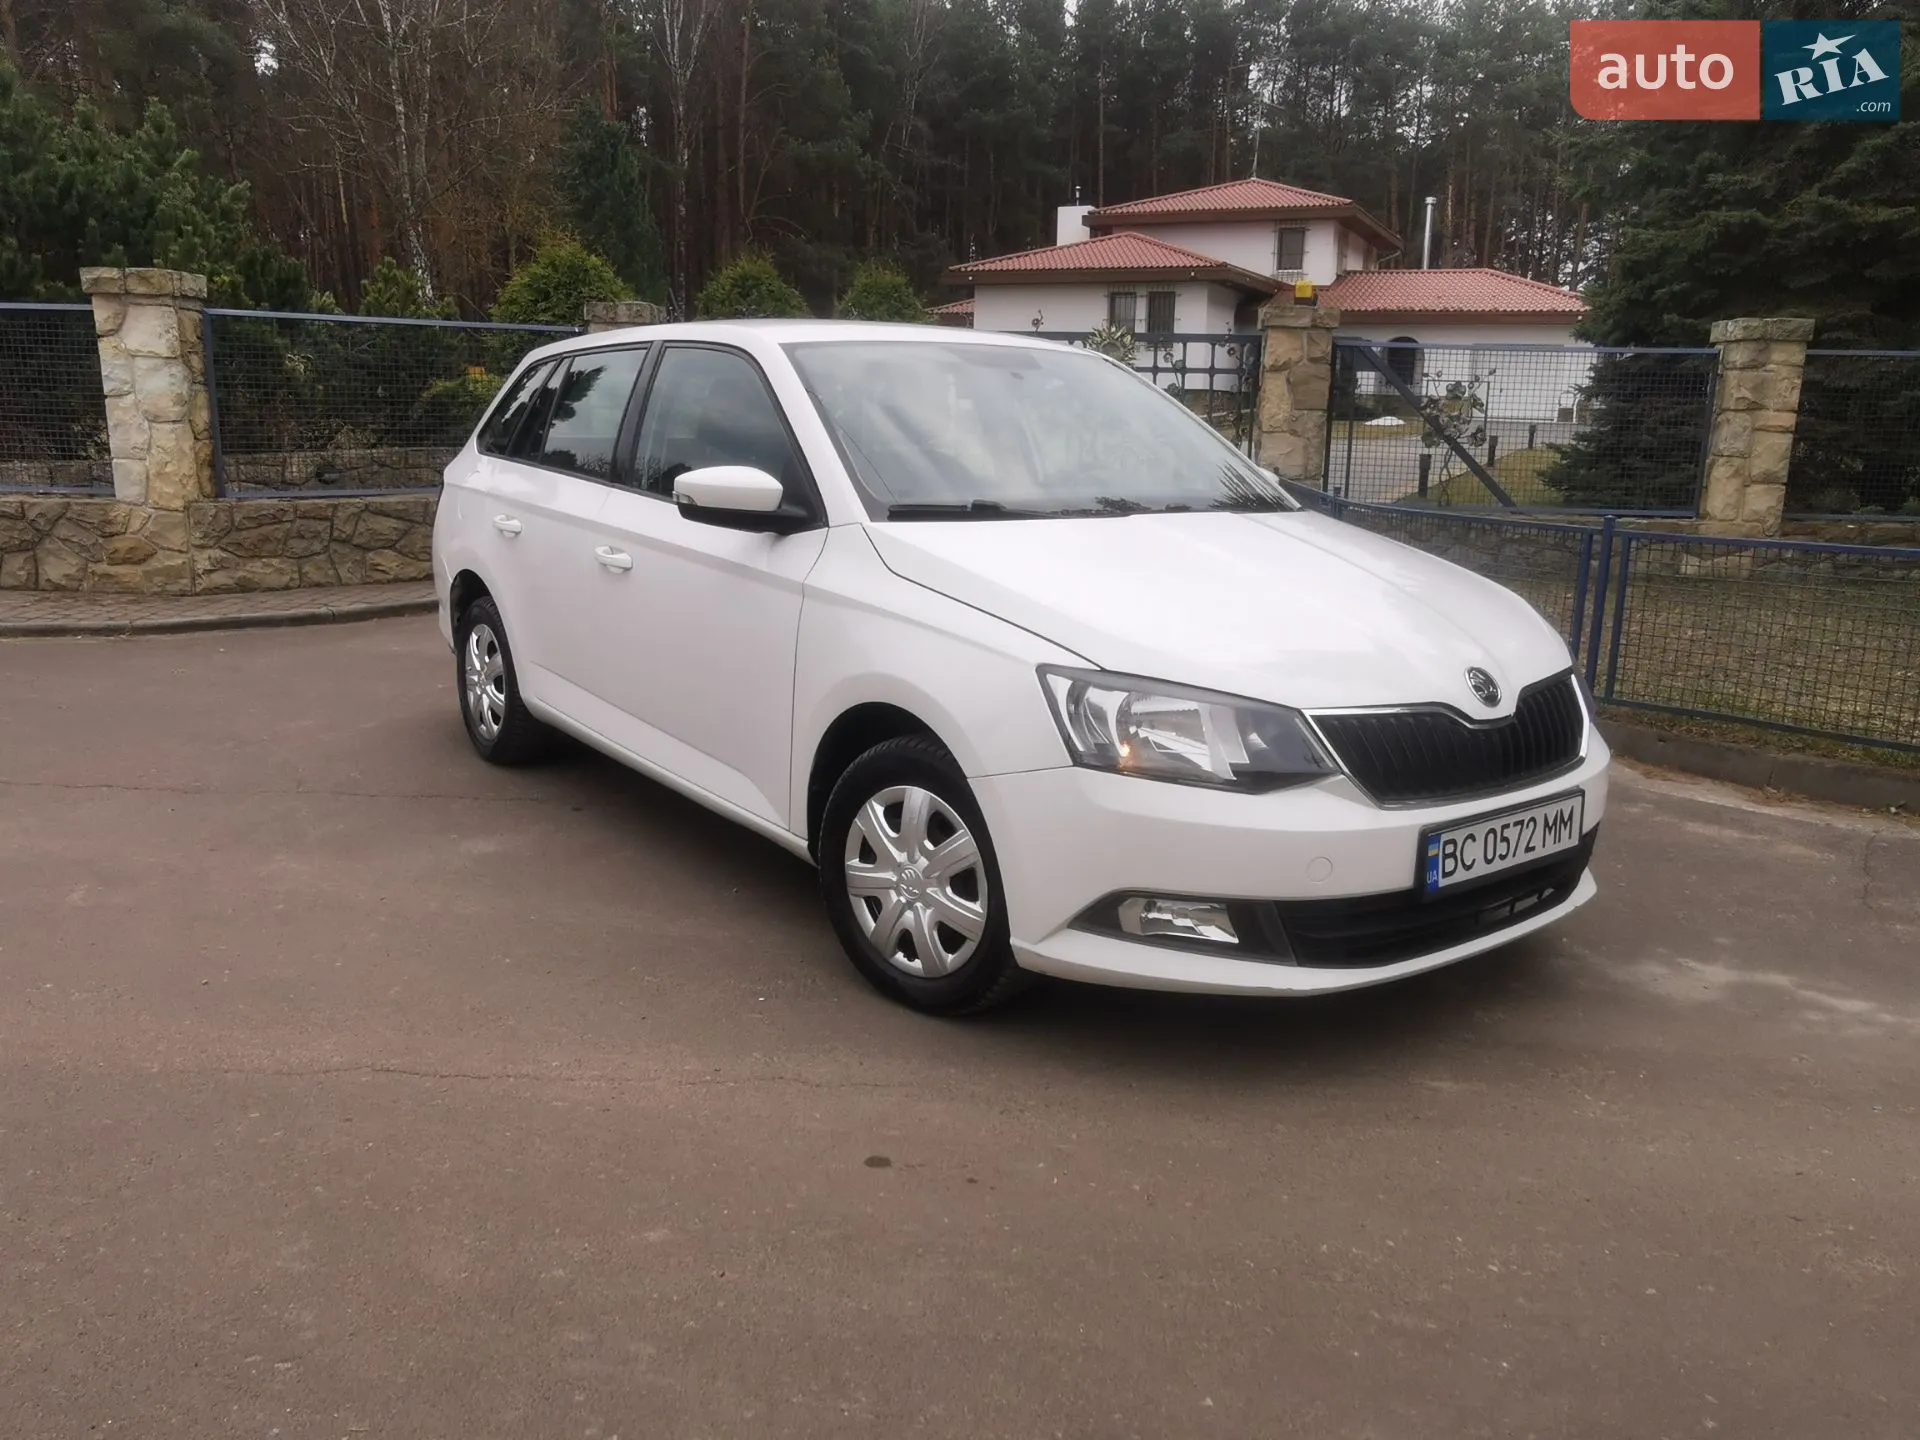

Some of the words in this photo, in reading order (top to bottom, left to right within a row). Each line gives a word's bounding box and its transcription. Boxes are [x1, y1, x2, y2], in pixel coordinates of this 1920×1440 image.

[1441, 833, 1477, 880] BC
[1483, 815, 1538, 866] 0572
[1542, 804, 1575, 849] MM
[1426, 870, 1439, 884] UA
